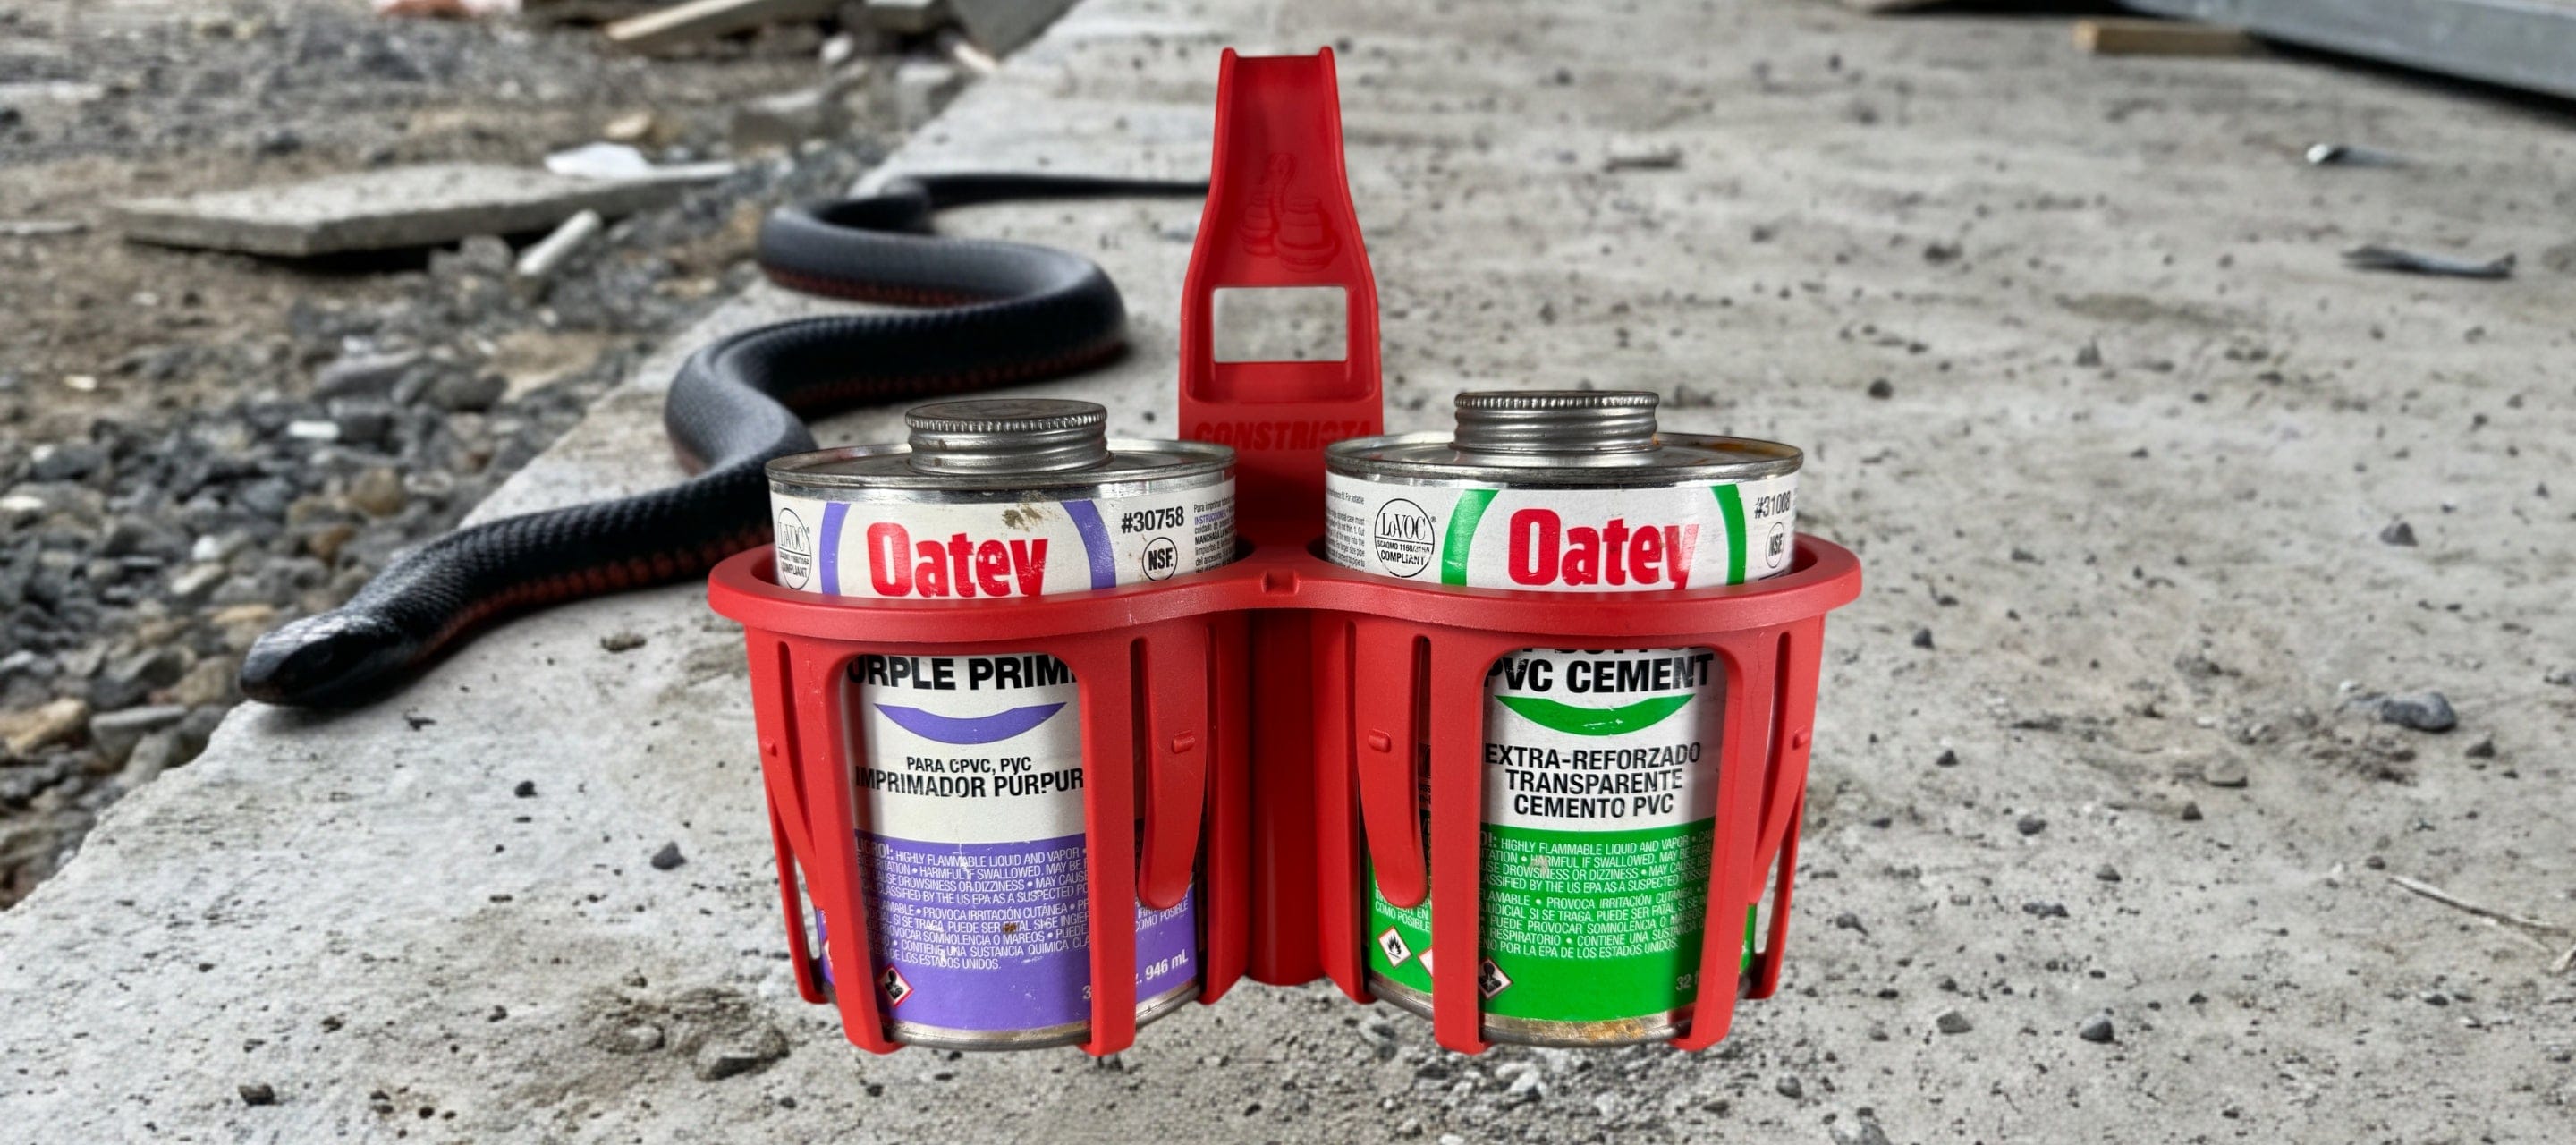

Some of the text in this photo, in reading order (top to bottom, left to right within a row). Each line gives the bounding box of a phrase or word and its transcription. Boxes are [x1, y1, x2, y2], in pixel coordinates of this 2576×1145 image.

[1755, 491, 1791, 519] #31008
[1121, 506, 1184, 534] #30758
[1380, 549, 1424, 565] COMPLIANT
[1509, 509, 1699, 590] Oatey
[969, 654, 1077, 690] PRIM
[1567, 654, 1713, 693] CEMENT
[906, 756, 945, 773] PARA
[949, 758, 996, 776] CPVC,
[1485, 742, 1700, 770] EXTRA-REFORZADO
[856, 766, 987, 798] IMPRIMADOR
[1505, 768, 1682, 794] TRANSPARENTE
[1514, 793, 1674, 818] CEMENTO PVC
[1501, 838, 1536, 852] HIGHLY
[1539, 843, 1602, 856] FLAMMABLE
[1606, 843, 1637, 856] LIQUID
[1639, 840, 1659, 853] AND
[1661, 835, 1689, 851] VAPOR
[896, 847, 1080, 868] HIGHLY FLAMMABLE LIQUID AND VAPOR
[1530, 854, 1580, 868] HARMFUL
[1582, 856, 1591, 868] IF
[1659, 849, 1678, 863] MAY
[1679, 846, 1690, 859] BE
[920, 866, 965, 880] HARMFUL
[1046, 861, 1067, 875] MAY
[1069, 859, 1082, 872] BE
[1503, 863, 1570, 880] DROWSINESS
[1572, 869, 1587, 881] OR
[1589, 867, 1639, 881] DIZZINESS
[1648, 863, 1668, 877] MAY
[898, 875, 957, 893] DROWSINESS
[958, 880, 973, 892] OR
[974, 878, 1025, 893] DIZZINESS
[1035, 876, 1056, 889] MAY
[1529, 879, 1542, 891] BY
[1545, 880, 1564, 893] THE
[1566, 882, 1581, 893] US
[1583, 882, 1602, 893] EPA
[1603, 881, 1618, 893] AS
[1618, 880, 1626, 892] A
[1628, 874, 1679, 892] SUSPECTED
[923, 890, 936, 903] BY
[936, 892, 955, 903] THE
[957, 893, 970, 905] US
[971, 893, 992, 905] EPA
[992, 893, 1006, 904] AS
[1007, 892, 1016, 903] A
[1017, 885, 1074, 903] SUSPECTED
[1546, 896, 1595, 910] PROVOCA
[1599, 893, 1652, 909] IRRITACIÓN
[923, 906, 967, 920] PROVOCA
[968, 906, 1021, 921] IRRITACIÓN
[1023, 903, 1069, 919] CUTÁNEA
[1160, 899, 1188, 923] POSIBLE
[1376, 900, 1396, 920] COMO
[1397, 910, 1430, 932] POSIBLE
[1416, 907, 1428, 920] EN
[1529, 907, 1538, 920] SI
[1541, 909, 1555, 921] SE
[1597, 908, 1629, 922] PUEDE
[1631, 906, 1650, 920] SER
[1651, 902, 1676, 917] FATAL
[893, 913, 902, 926] SI
[902, 915, 914, 929] SE
[948, 921, 980, 934] PUEDE
[981, 920, 1002, 934] SER
[1045, 916, 1058, 929] SE
[1490, 914, 1523, 930] PUEDE
[1527, 920, 1583, 935] PROVOCAR
[1587, 918, 1657, 934] SOMNOLENCIA
[1659, 915, 1666, 928] O
[923, 931, 992, 946] SOMNOLENCIA
[993, 934, 1001, 946] O
[1003, 930, 1045, 946] MAREOS
[1055, 923, 1089, 939] PUEDE
[1489, 928, 1561, 946] RESPIRATORIO
[1577, 933, 1625, 946] CONTIENE
[1629, 930, 1648, 944] UNA
[902, 939, 945, 955] CONTIENE
[970, 945, 1025, 958] SUSTANCIA
[1499, 940, 1521, 954] POR
[1523, 944, 1537, 956] LA
[1538, 945, 1558, 958] EPA
[1561, 946, 1574, 959] DE
[1577, 946, 1597, 959] LOS
[1599, 944, 1642, 959] ESTADOS
[1644, 937, 1679, 954] UNIDOS.
[889, 948, 901, 961] DE
[902, 950, 919, 963] LOS
[919, 954, 961, 967] ESTADOS
[962, 957, 1001, 970] UNIDOS.
[1146, 949, 1188, 980] 946 mL
[1675, 973, 1691, 991] 32
